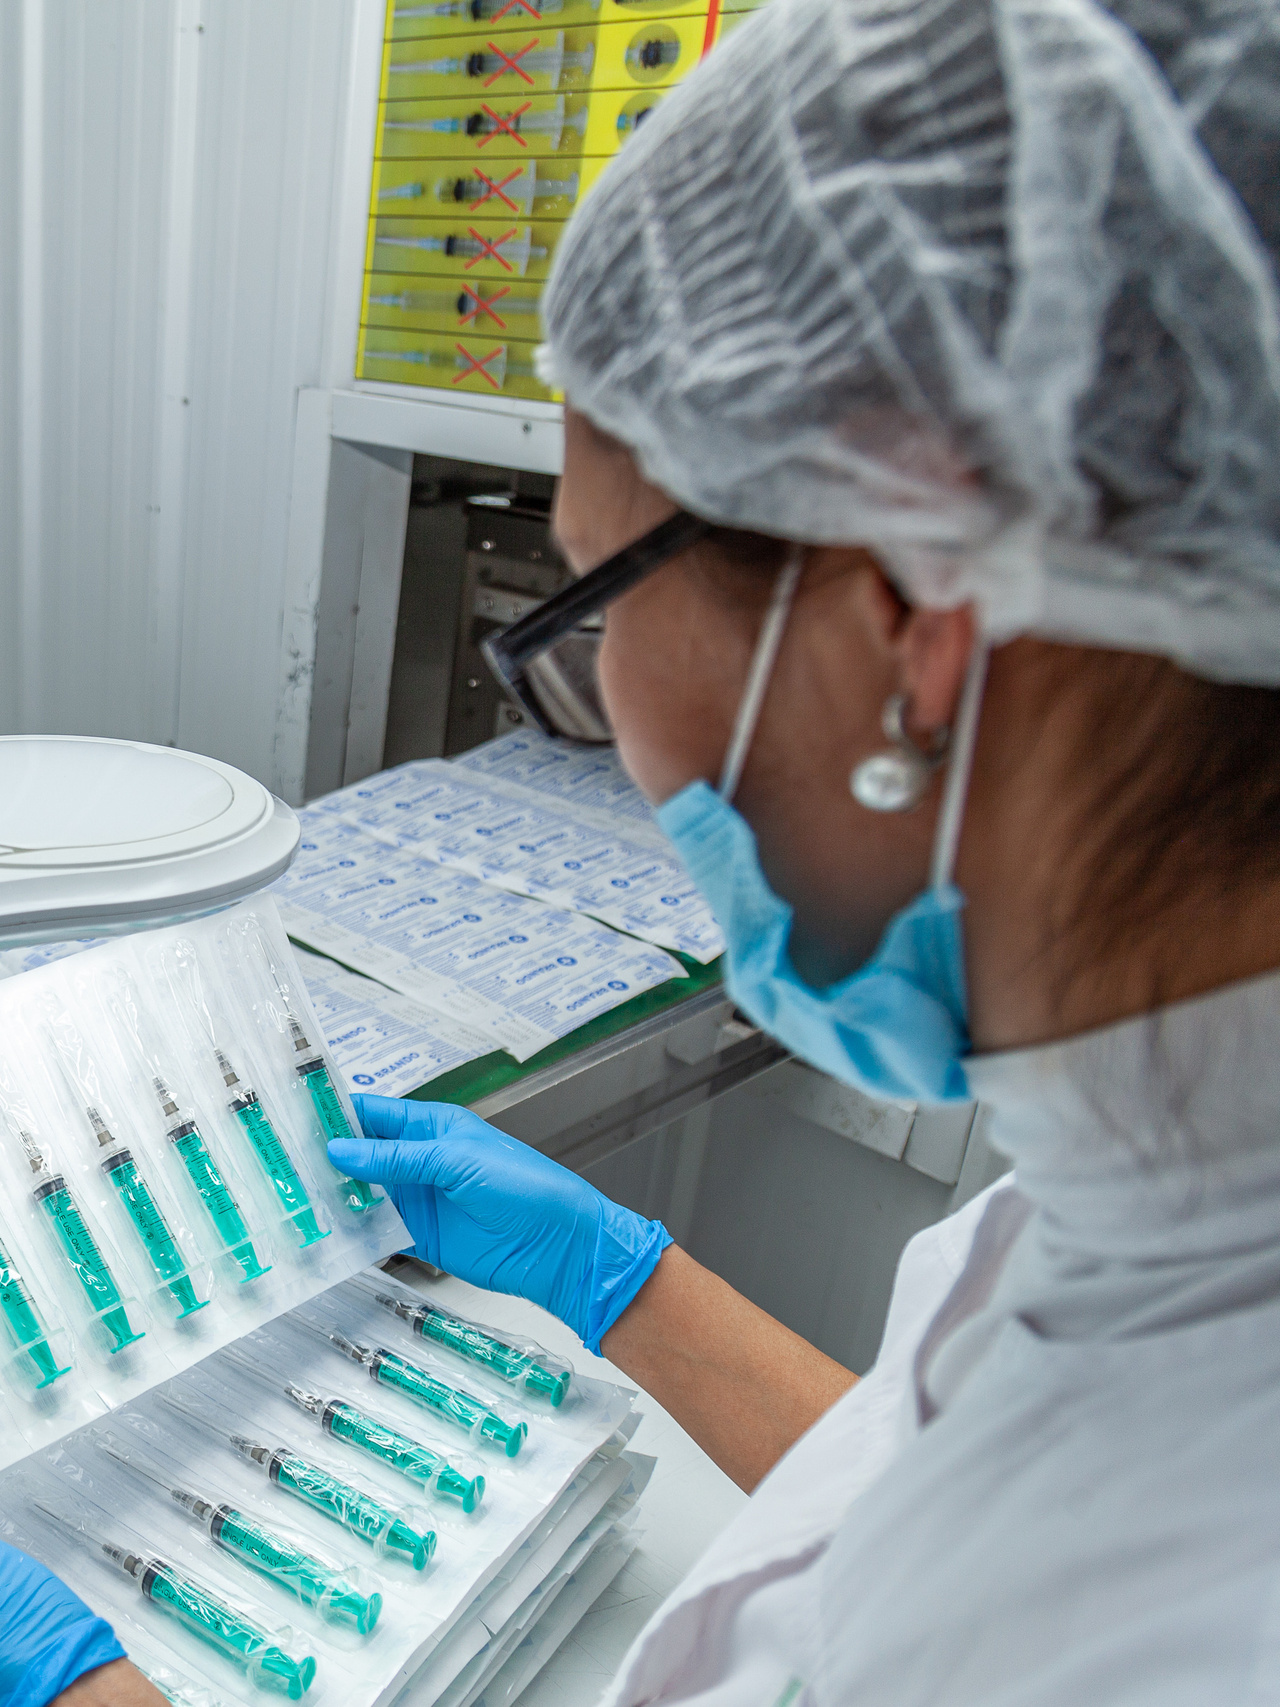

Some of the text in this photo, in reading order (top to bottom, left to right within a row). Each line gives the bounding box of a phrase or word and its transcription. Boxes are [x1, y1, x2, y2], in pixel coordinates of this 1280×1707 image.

[373, 1050, 420, 1080] BRANDO
[318, 1098, 335, 1130] USE ONLY
[239, 1109, 273, 1166] SINGLE USE ONLY
[187, 1167, 198, 1181] USE
[48, 1195, 84, 1258] SINGLE USE ONLY
[134, 1210, 148, 1230] ONLY
[219, 1528, 245, 1547] SINGLE
[259, 1553, 278, 1568] ONLY
[176, 1599, 192, 1612] USE
